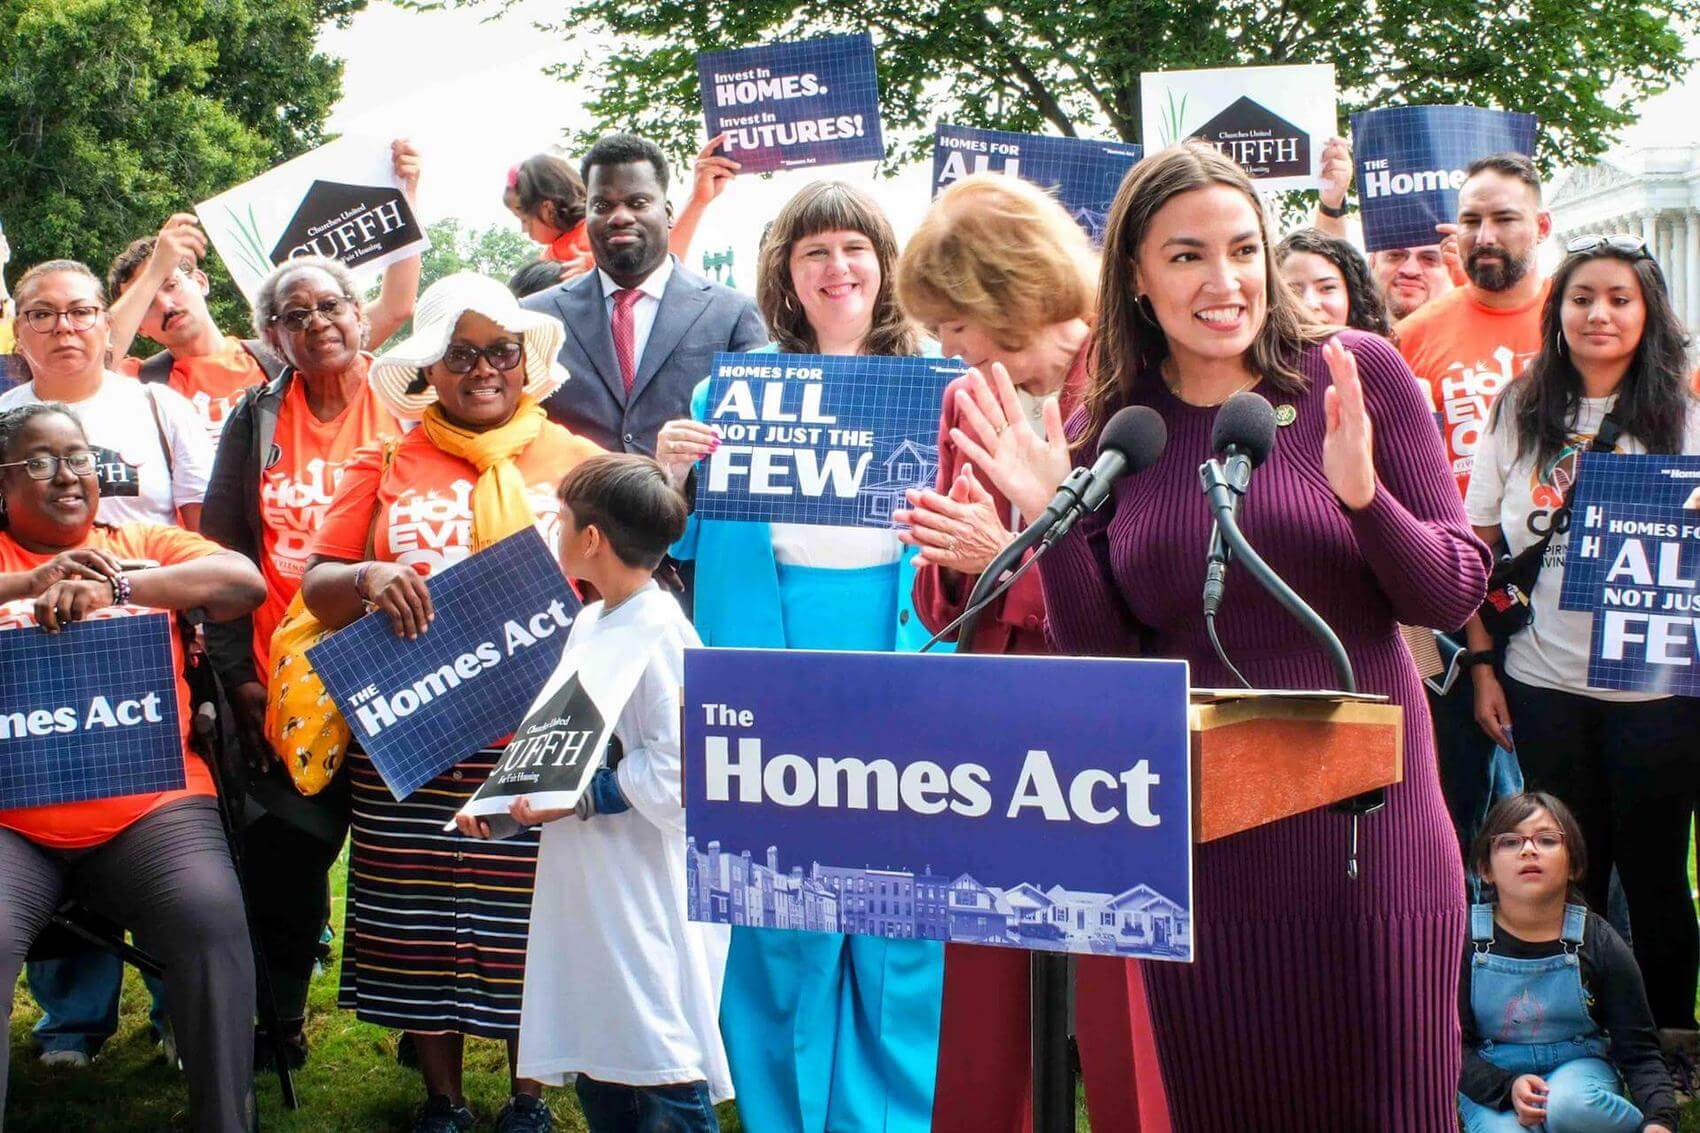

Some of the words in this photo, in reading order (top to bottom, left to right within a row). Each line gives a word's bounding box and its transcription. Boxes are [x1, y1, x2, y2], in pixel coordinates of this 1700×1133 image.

[714, 71, 754, 84] Invest
[757, 68, 771, 78] In
[716, 73, 828, 107] HOMES.
[720, 114, 760, 128] Invest
[762, 112, 776, 123] In
[722, 114, 864, 153] FUTURES!
[939, 136, 987, 152] HOMES
[990, 143, 1019, 156] FOR
[1363, 158, 1389, 171] THE
[718, 365, 782, 379] HOMES
[785, 367, 823, 380] FOR
[712, 380, 837, 424] ALL
[712, 424, 761, 441] NOT
[764, 426, 823, 445] JUST
[828, 429, 874, 447] THE
[708, 445, 874, 498] FEW
[1609, 519, 1677, 538] HOMES
[1603, 588, 1657, 607] NOT
[1601, 610, 1700, 666] FE
[354, 641, 501, 737] Homes
[503, 599, 573, 656] Act
[348, 683, 380, 707] THE
[85, 692, 162, 730] Act
[702, 703, 754, 728] The
[705, 735, 992, 817] Homes
[1006, 750, 1161, 827] Act
